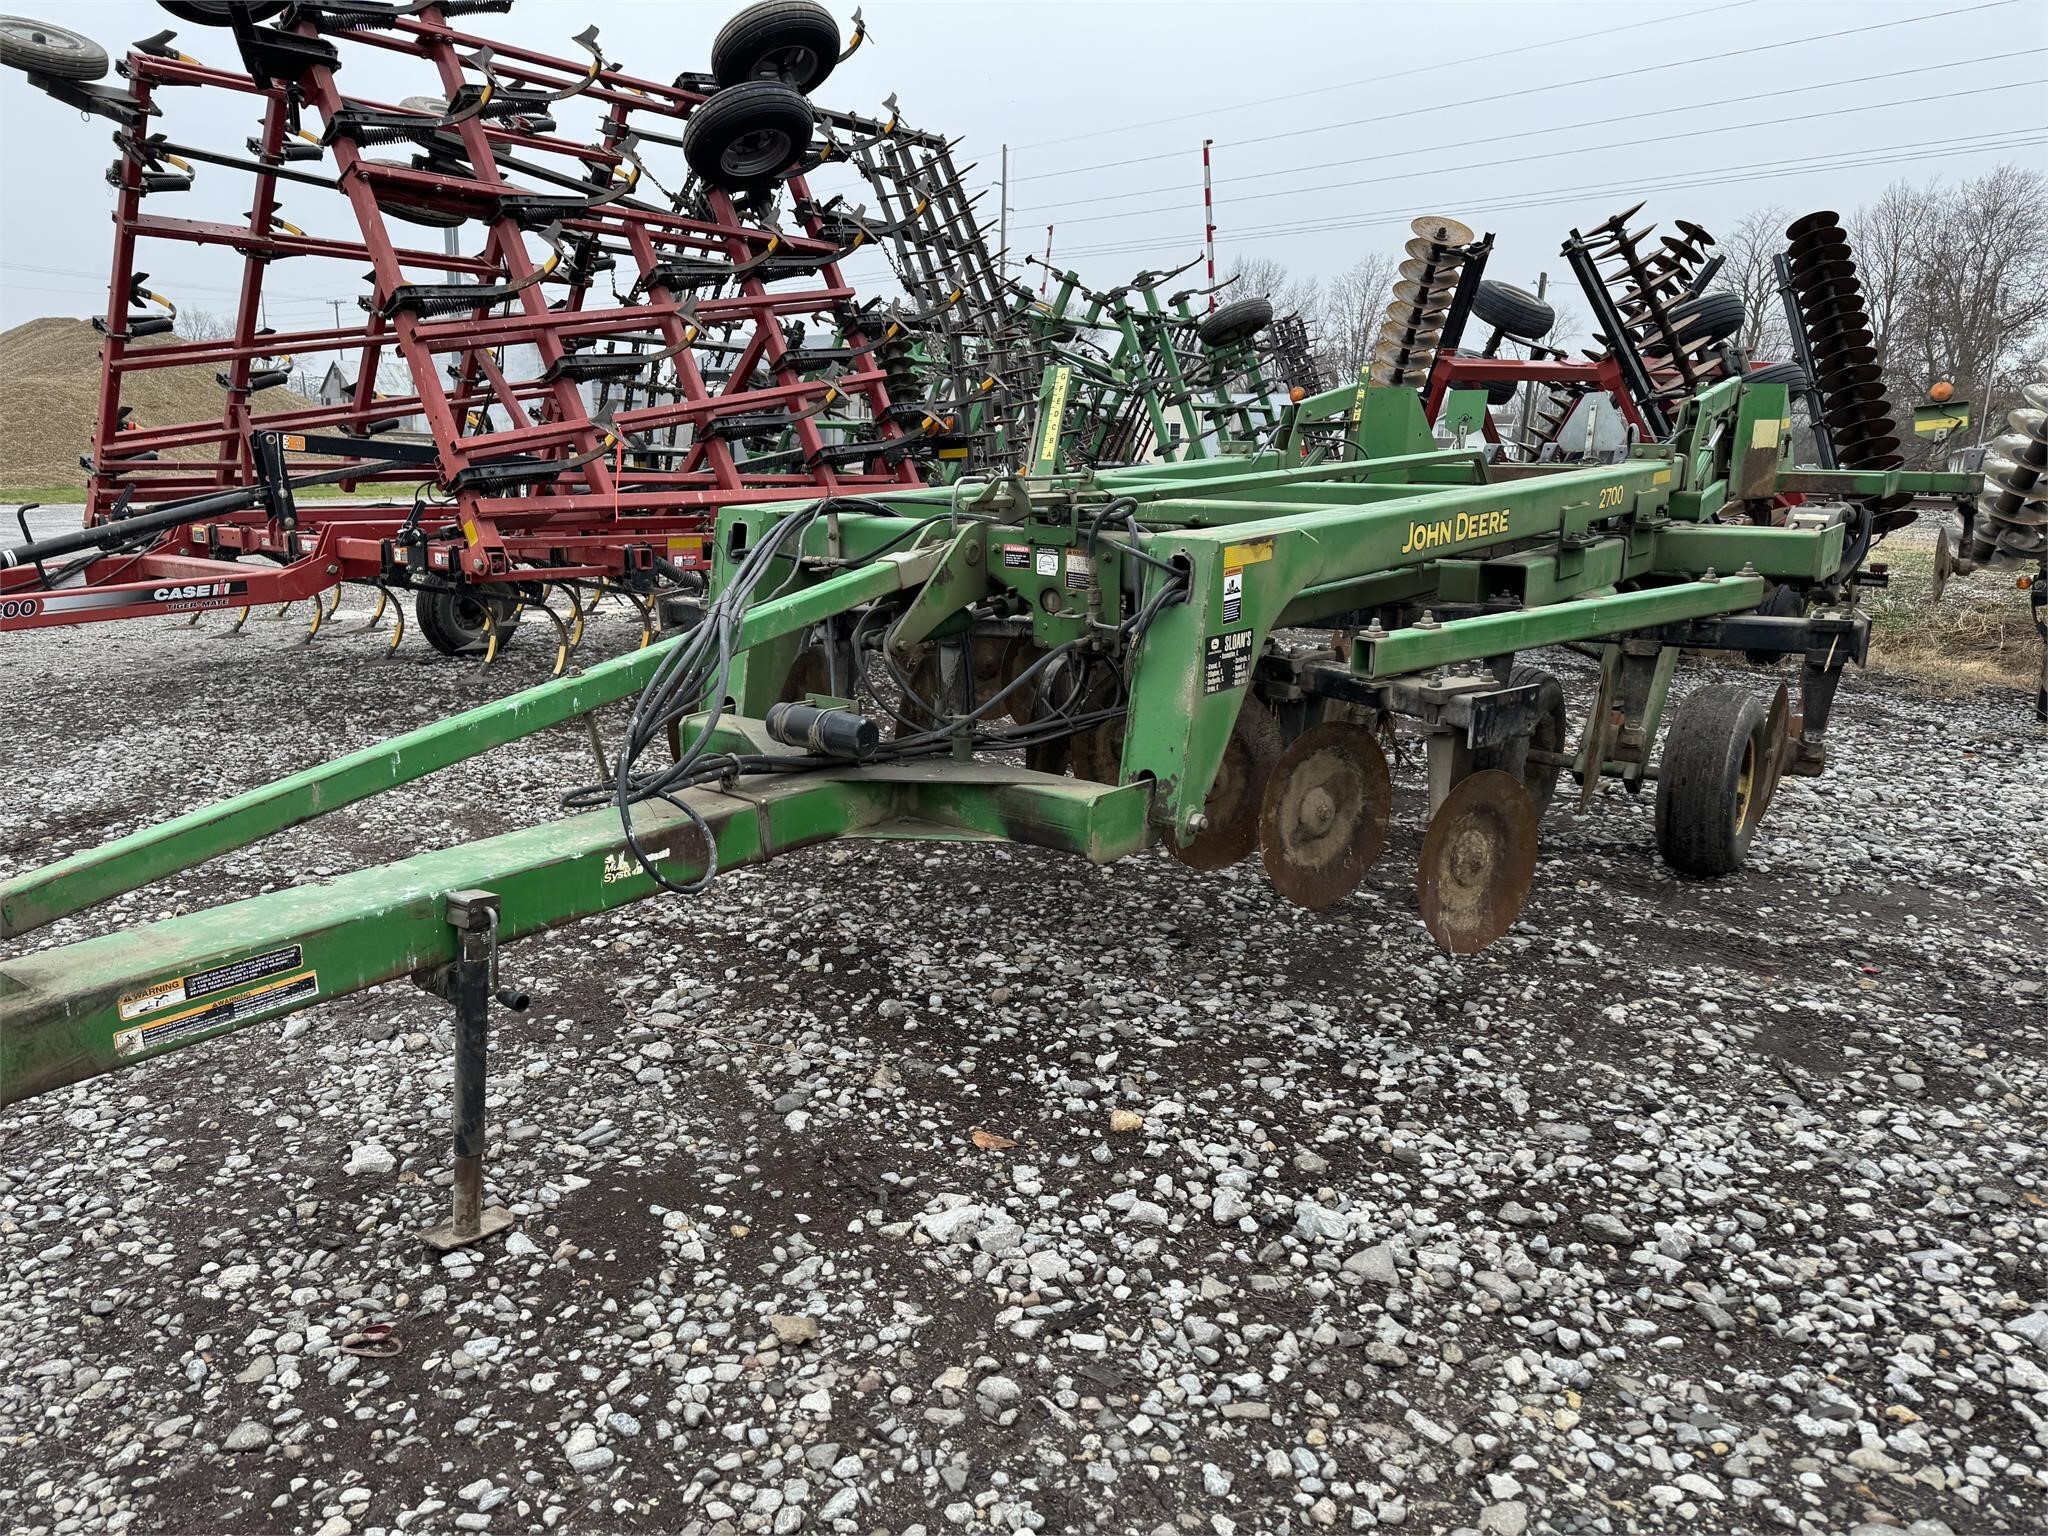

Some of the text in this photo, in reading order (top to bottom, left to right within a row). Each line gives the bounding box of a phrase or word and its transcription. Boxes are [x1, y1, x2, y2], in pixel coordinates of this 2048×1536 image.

[1599, 485, 1624, 510] 2700
[1402, 508, 1510, 554] JOHN DEERE
[154, 584, 210, 601] CASE
[0, 598, 37, 619] 00
[1224, 631, 1251, 651] SLOAN'S
[133, 980, 180, 1000] WARNING
[217, 991, 252, 1006] WARNING
